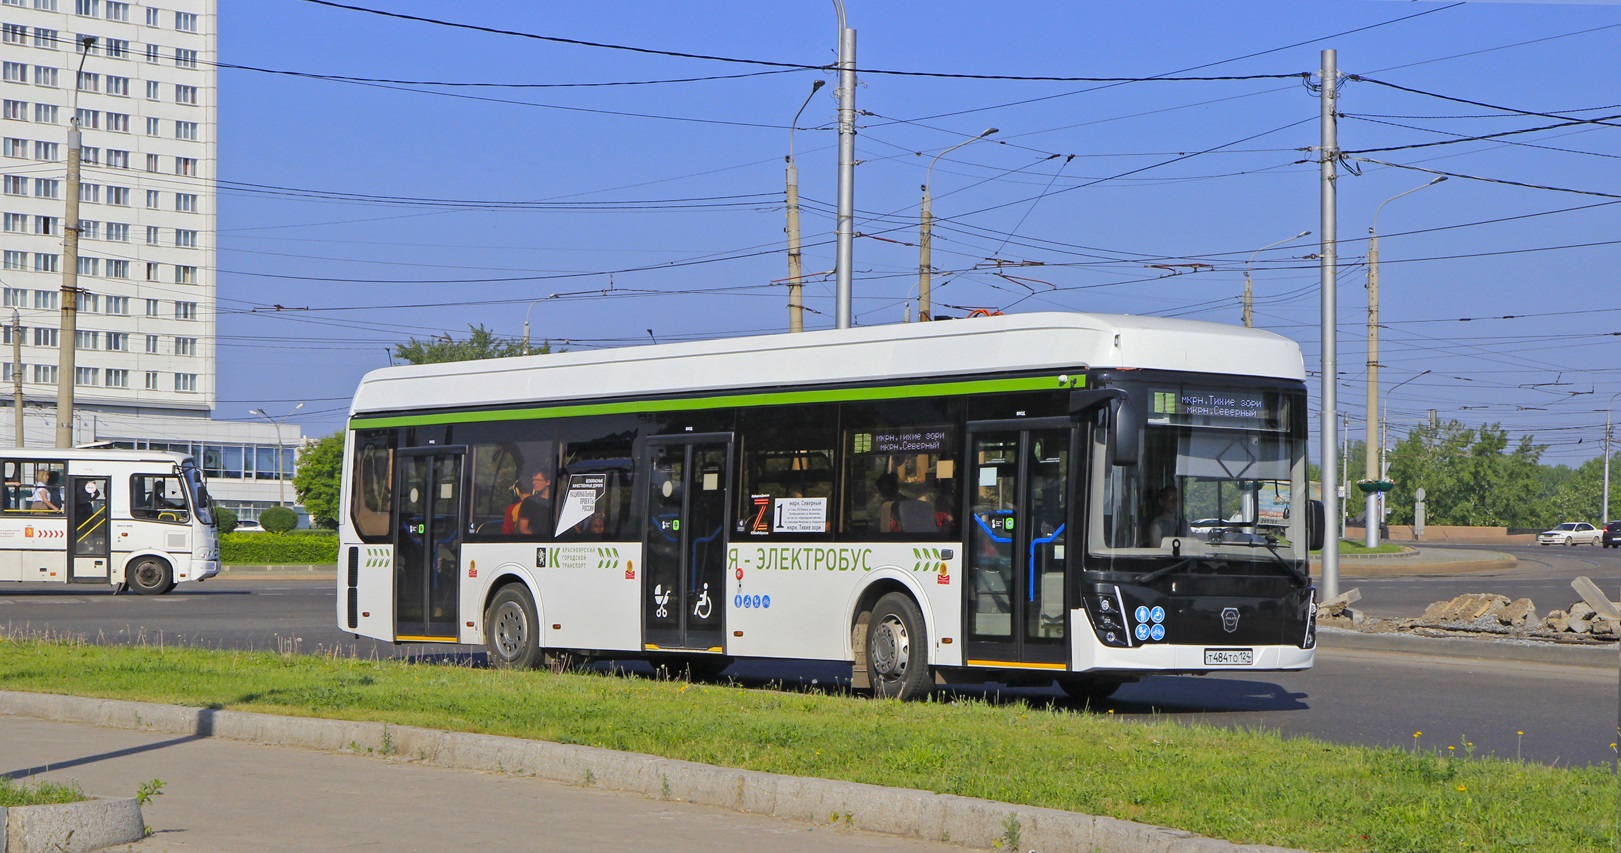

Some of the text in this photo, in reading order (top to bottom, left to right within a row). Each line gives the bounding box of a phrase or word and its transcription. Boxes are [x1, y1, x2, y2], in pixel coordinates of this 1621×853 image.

[1181, 395, 1262, 409] мкрн.Тихие зори
[1186, 405, 1257, 418] мкрн.Северный
[776, 503, 784, 529] 1
[728, 548, 738, 570] Я
[756, 547, 872, 571] ЭЛЕКТРОБУС
